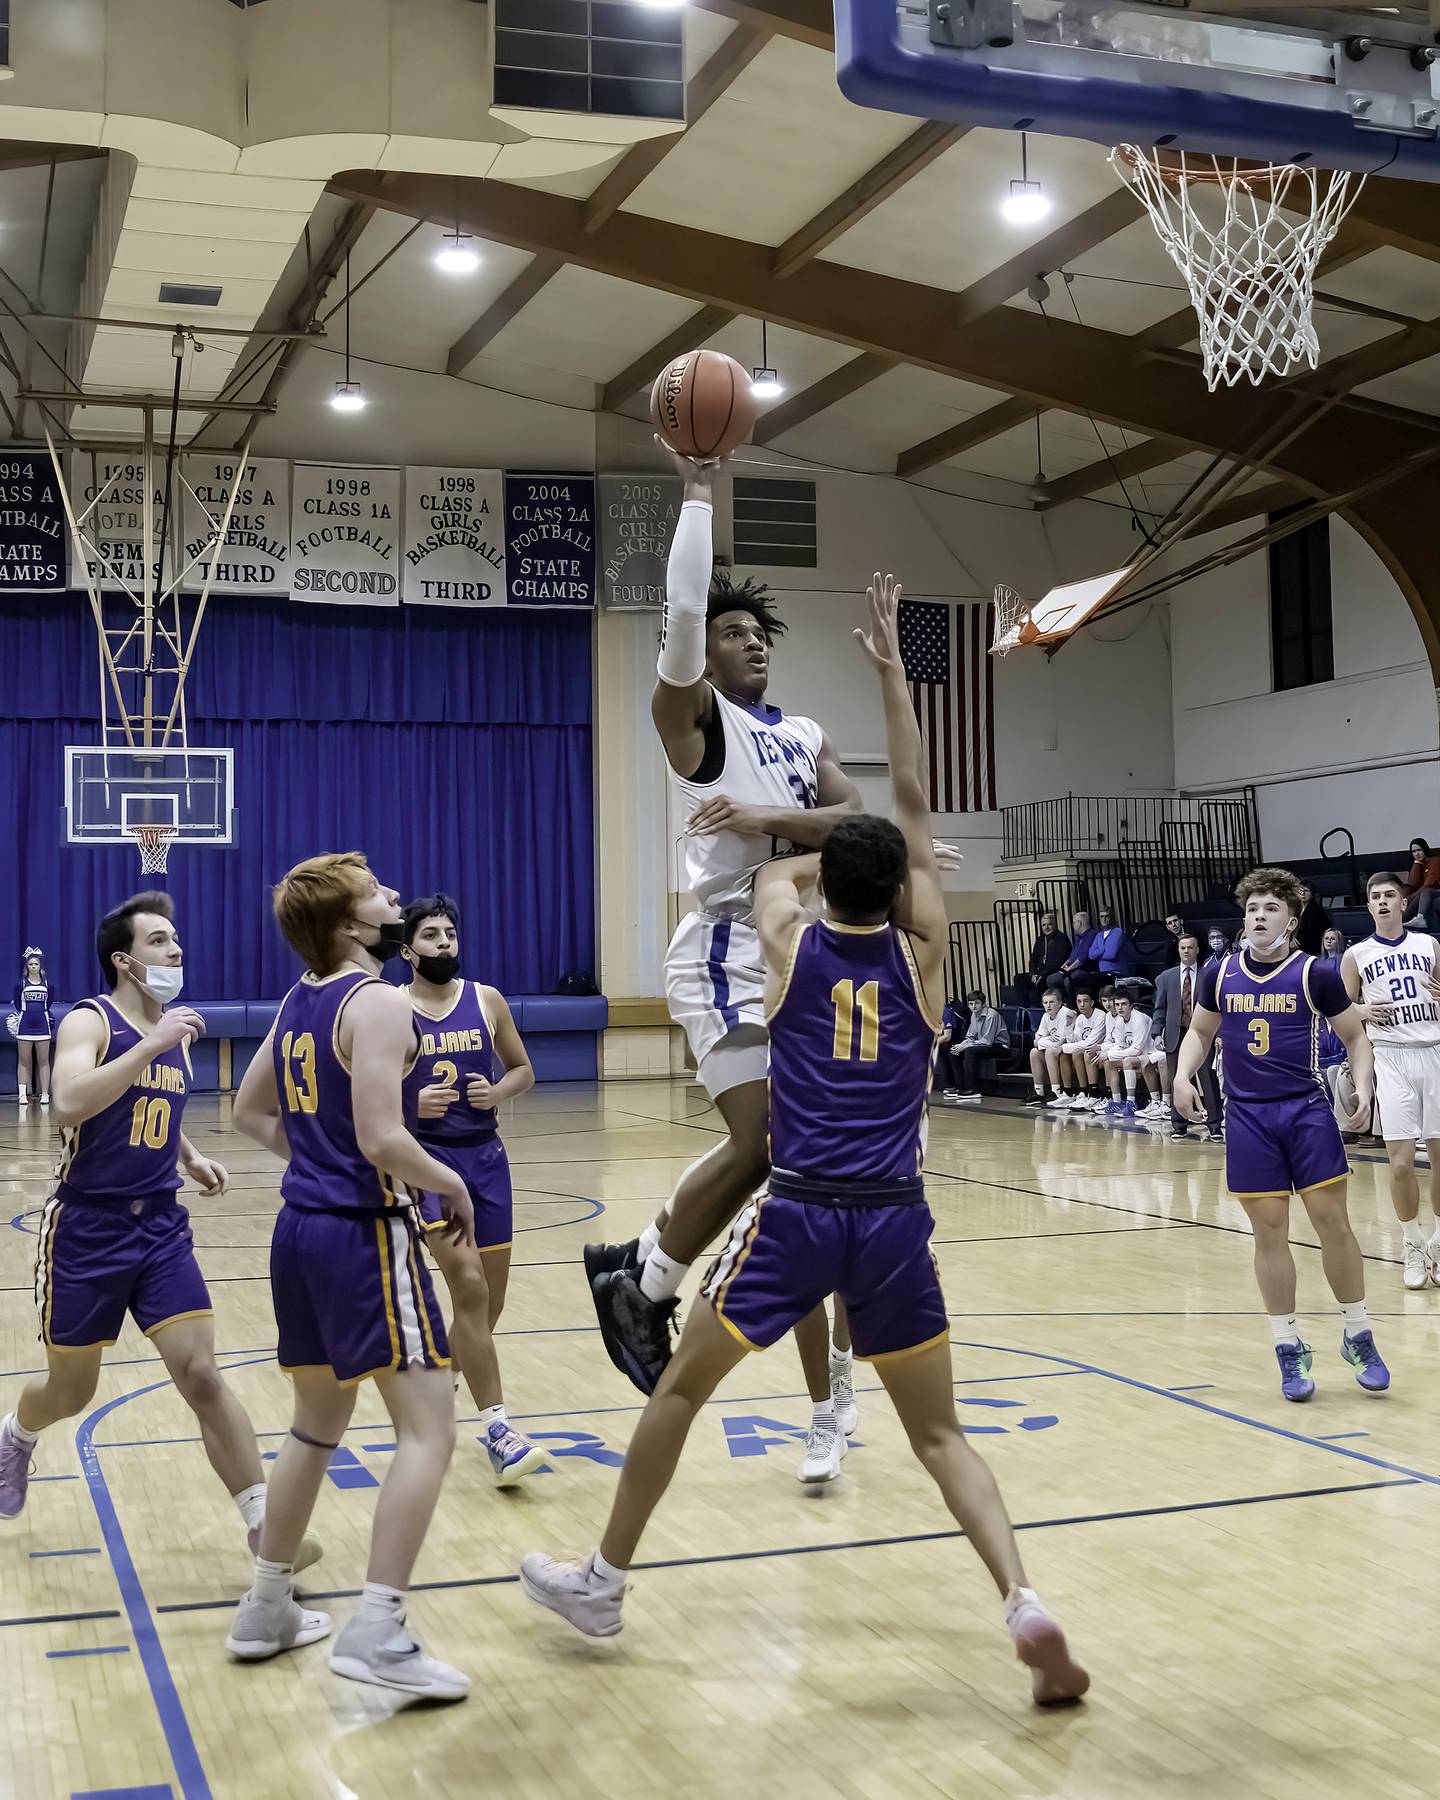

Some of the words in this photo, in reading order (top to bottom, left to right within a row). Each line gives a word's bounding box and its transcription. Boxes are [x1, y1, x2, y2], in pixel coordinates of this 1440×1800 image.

[0, 463, 34, 479] 994
[104, 465, 144, 481] 1995
[0, 486, 33, 502] ASS
[41, 486, 54, 502] A
[326, 479, 371, 496] 1998
[439, 477, 475, 493] 1998
[528, 485, 571, 501] 2004
[621, 485, 661, 501] 2005
[153, 489, 166, 505] A
[262, 490, 275, 505] A
[420, 494, 472, 512] CLASS
[479, 498, 490, 513] A
[303, 499, 361, 516] CLASS
[371, 503, 391, 519] 1A
[512, 505, 562, 524] CLASS
[569, 507, 590, 522] 2A
[608, 503, 660, 519] CLASS
[665, 504, 676, 519] A
[0, 510, 60, 538] TBALL
[430, 513, 482, 533] GIRLS
[619, 521, 666, 537] GIRLS
[296, 526, 393, 560] FOOTBALL
[510, 523, 592, 555] FOOTBALL
[405, 530, 505, 570] BASKETBALL
[0, 564, 58, 581] AMPS
[198, 562, 275, 583] THIRD
[519, 558, 581, 577] STATE
[293, 568, 397, 595] SECOND
[420, 580, 492, 601] THIRD
[511, 579, 589, 600] CHAMPS
[611, 585, 664, 602] FOURT
[1363, 952, 1431, 984] NEWMAN
[1388, 975, 1417, 1002] 20
[1225, 993, 1297, 1013] TROJANS
[831, 978, 880, 1062] 11
[420, 1028, 483, 1056] OJANS
[1247, 1018, 1270, 1056] 3
[281, 1030, 318, 1115] 13
[433, 1060, 460, 1101] 2
[129, 1095, 171, 1149] 10
